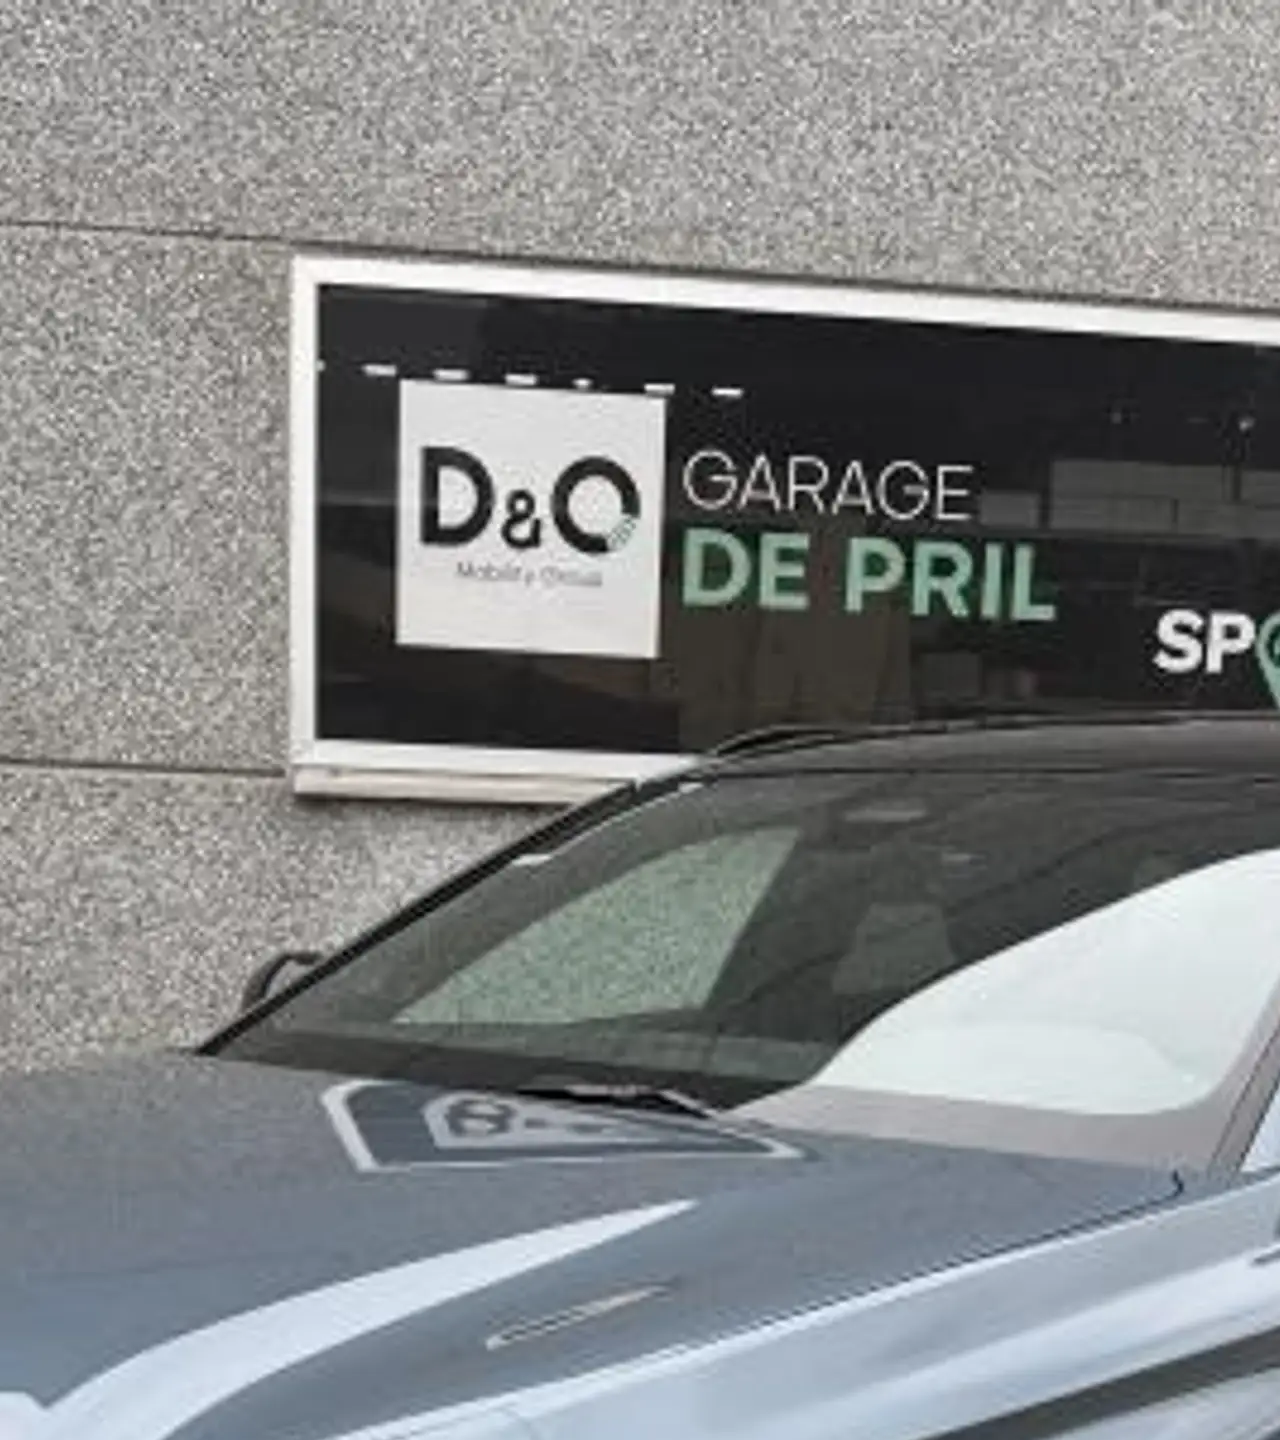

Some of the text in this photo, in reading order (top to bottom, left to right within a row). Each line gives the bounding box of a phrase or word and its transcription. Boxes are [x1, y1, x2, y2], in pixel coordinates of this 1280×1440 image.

[682, 451, 974, 520] GARAGE
[684, 528, 1057, 621] DE PRIL
